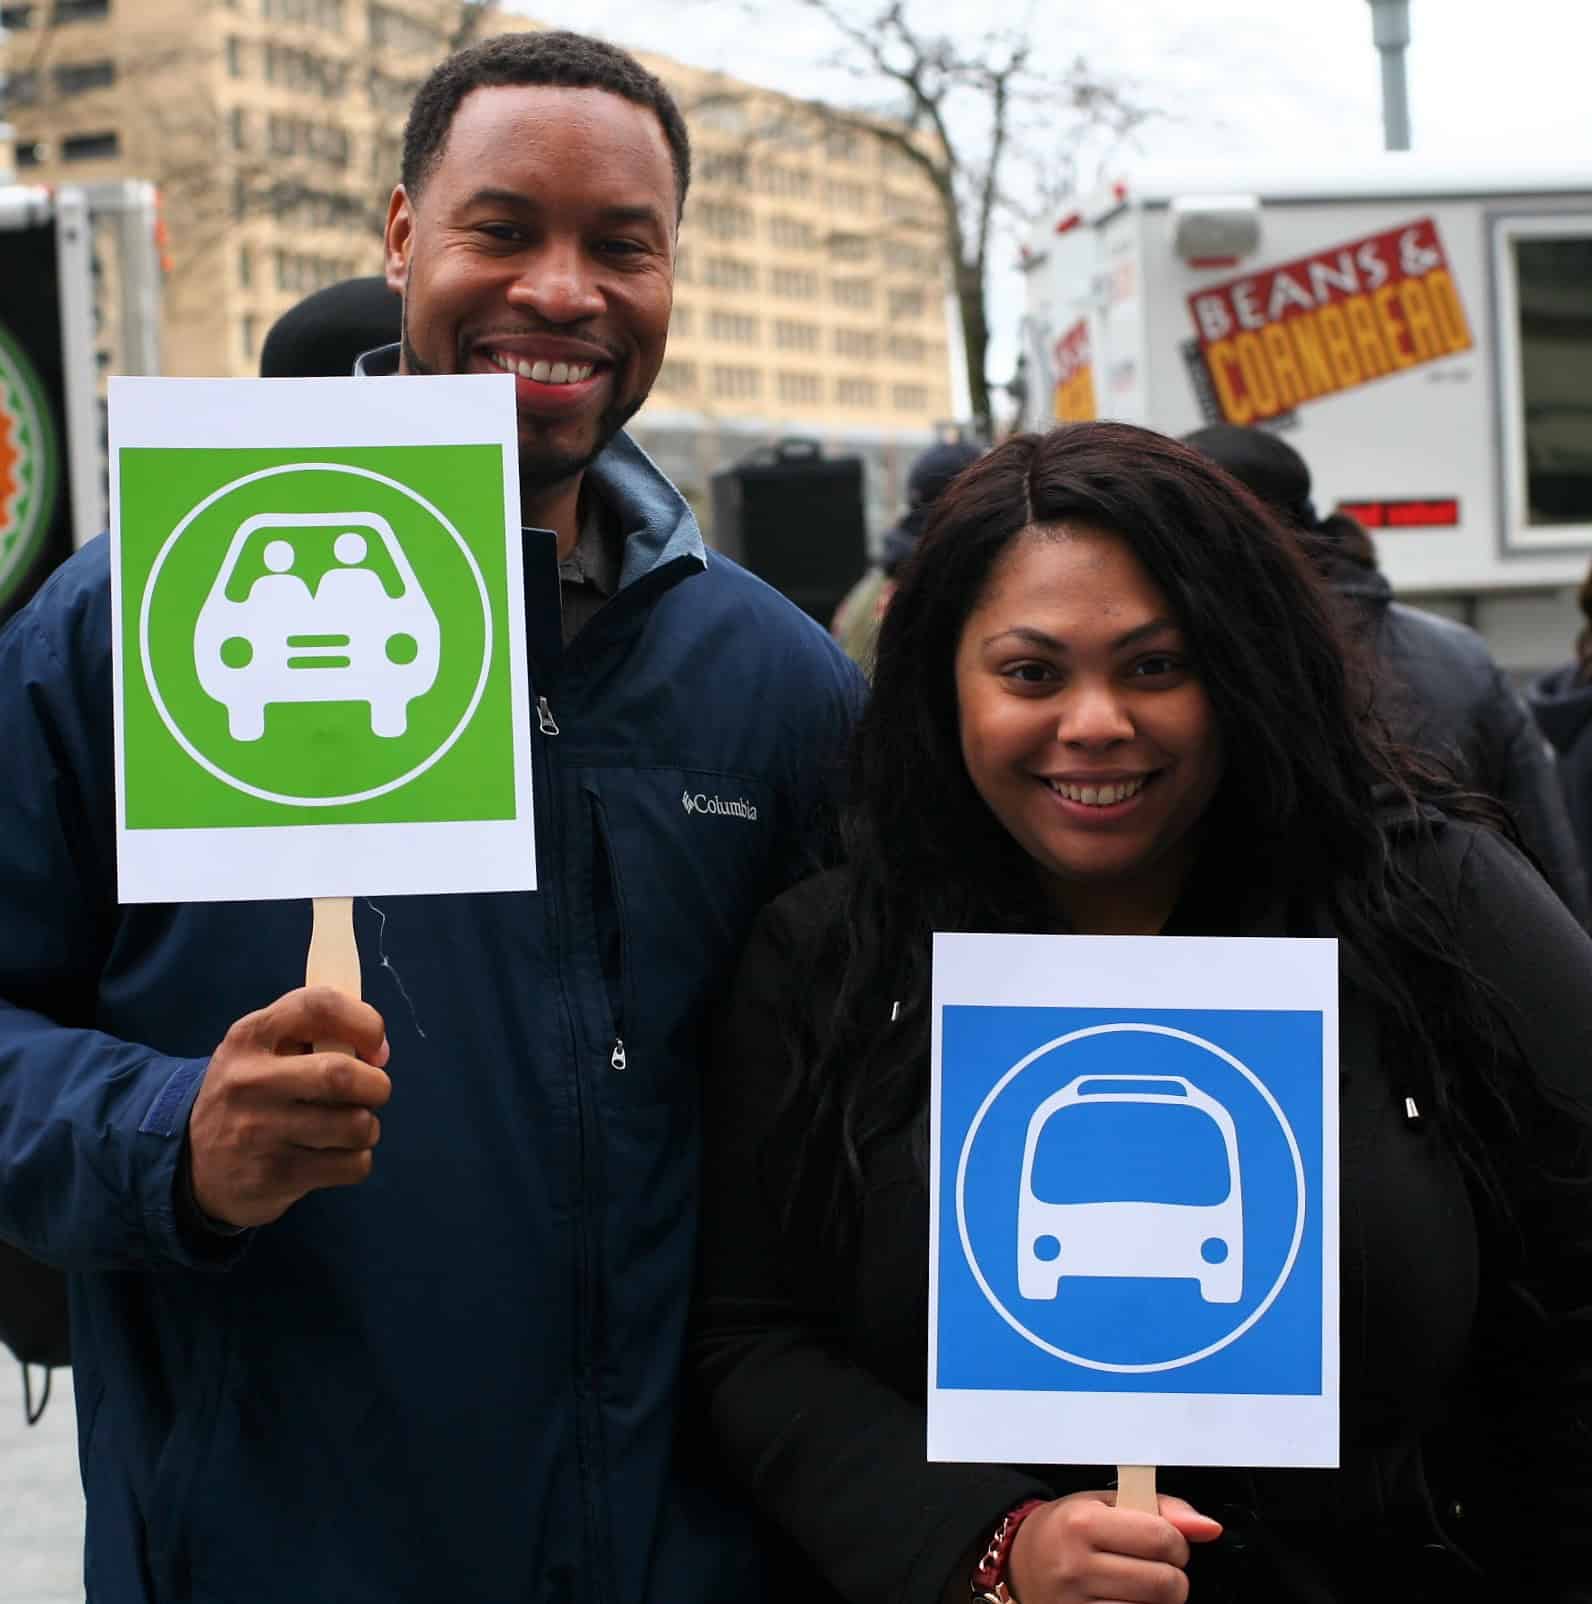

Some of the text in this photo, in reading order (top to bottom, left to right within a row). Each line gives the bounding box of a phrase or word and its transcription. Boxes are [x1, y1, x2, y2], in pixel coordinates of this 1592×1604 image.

[1195, 241, 1388, 341] BEANS
[1399, 227, 1440, 276] &
[1207, 269, 1473, 426] CORNBREAD
[694, 794, 757, 820] Columbia
